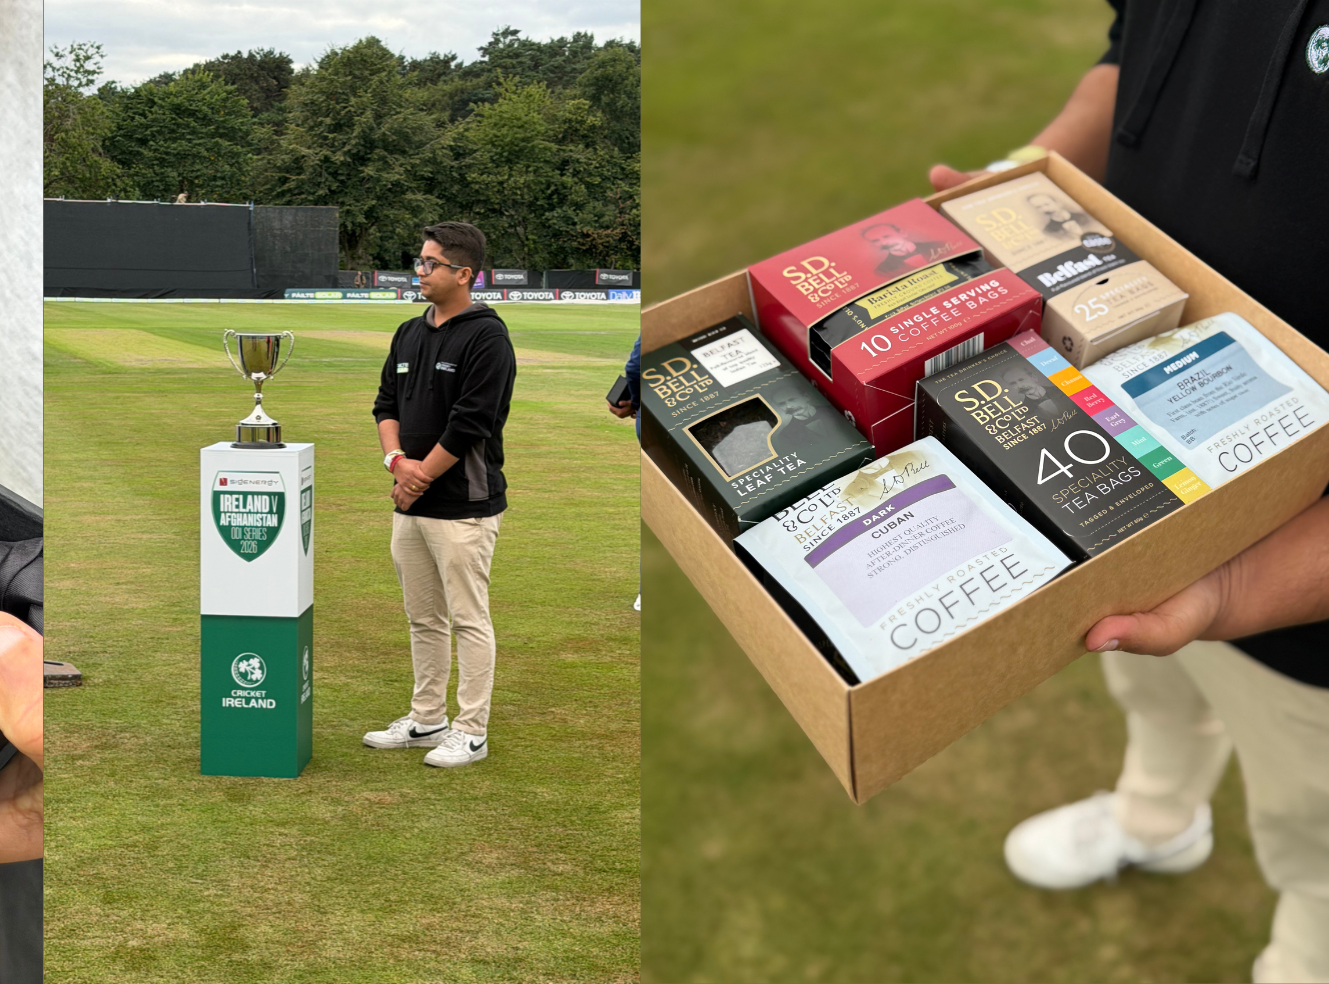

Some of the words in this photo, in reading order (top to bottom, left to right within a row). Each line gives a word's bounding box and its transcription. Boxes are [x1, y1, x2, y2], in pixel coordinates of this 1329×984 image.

[782, 256, 836, 284] S.D.
[796, 268, 847, 295] BELL
[1037, 253, 1103, 287] Belfast
[471, 292, 502, 300] TOYOTA
[523, 292, 554, 300] TOYOTA
[575, 292, 607, 300] TOYOTA
[610, 291, 633, 300] Daily
[816, 293, 841, 308] SINCE
[842, 283, 860, 294] 1887
[867, 283, 908, 305] Barista
[908, 270, 938, 286] Roast
[889, 306, 939, 334] SINGLE
[942, 279, 1000, 309] SERVING
[898, 307, 962, 342] COFFEE
[966, 286, 1009, 310] BAGS
[1074, 297, 1109, 322] 25
[926, 332, 938, 341] NET
[938, 327, 948, 336] WT
[948, 321, 963, 333] 100g
[703, 337, 745, 357] BELFAST
[721, 349, 742, 360] TEA
[860, 333, 892, 358] 10
[642, 357, 698, 387] S.D.
[947, 371, 958, 379] TEA
[1122, 363, 1149, 379] SINCE
[1149, 350, 1168, 364] 1887
[1163, 351, 1200, 375] MEDIUM
[653, 370, 709, 399] BELL
[1167, 385, 1198, 404] YELLOW
[1198, 365, 1233, 388] BOURBON
[1176, 369, 1211, 390] BRAZIL
[672, 401, 698, 418] SINCE
[700, 391, 719, 403] 1887
[954, 379, 1009, 412] S.D.
[1084, 393, 1097, 401] Red
[1087, 398, 1105, 407] Berry
[971, 395, 1022, 426] BELL
[1105, 412, 1120, 423] Earl
[1110, 417, 1126, 428] Grey
[995, 415, 1041, 444] BELFAST
[1003, 433, 1029, 451] SINCE
[1028, 423, 1047, 436] 1887
[1207, 424, 1250, 454] FRESHLY
[1253, 397, 1300, 425] ROASTED
[1218, 405, 1316, 473] COFFEE
[1131, 436, 1147, 446] Mint
[731, 451, 798, 489] SPECIALITY
[1036, 429, 1111, 485] 40
[1152, 456, 1173, 469] Green
[737, 473, 774, 497] LEAF
[777, 458, 807, 476] TEA
[1051, 455, 1130, 504] SPECIALITY
[1061, 492, 1099, 515] TEA
[1097, 466, 1142, 496] BAGS
[1173, 476, 1197, 490] Lemon
[1180, 481, 1203, 496] Ginger
[220, 494, 270, 512] IRELAND
[271, 495, 278, 513] V
[862, 504, 896, 527] DARK
[1079, 510, 1108, 527] TAGGED
[1115, 482, 1154, 507] ENVELOPED
[220, 513, 278, 527] AFGHANISTAN
[231, 527, 242, 539] ODI
[244, 527, 267, 540] SERIES
[794, 496, 855, 544] BELFAST
[803, 524, 836, 552] SINCE
[836, 507, 861, 524] 1887
[871, 511, 915, 539] CUBAN
[240, 540, 257, 553] 2026
[866, 531, 929, 569] AFTER-DINNER
[924, 517, 957, 535] COFFEE
[867, 534, 903, 559] HIGHEST
[902, 515, 940, 538] QUALITY
[867, 554, 904, 578] STRONG,
[904, 522, 966, 558] DISTINGUISHED
[880, 584, 941, 631] FRESHLY
[946, 546, 1009, 584] ROASTED
[890, 553, 1029, 650] COFFEE
[222, 698, 276, 709] IRELAND
